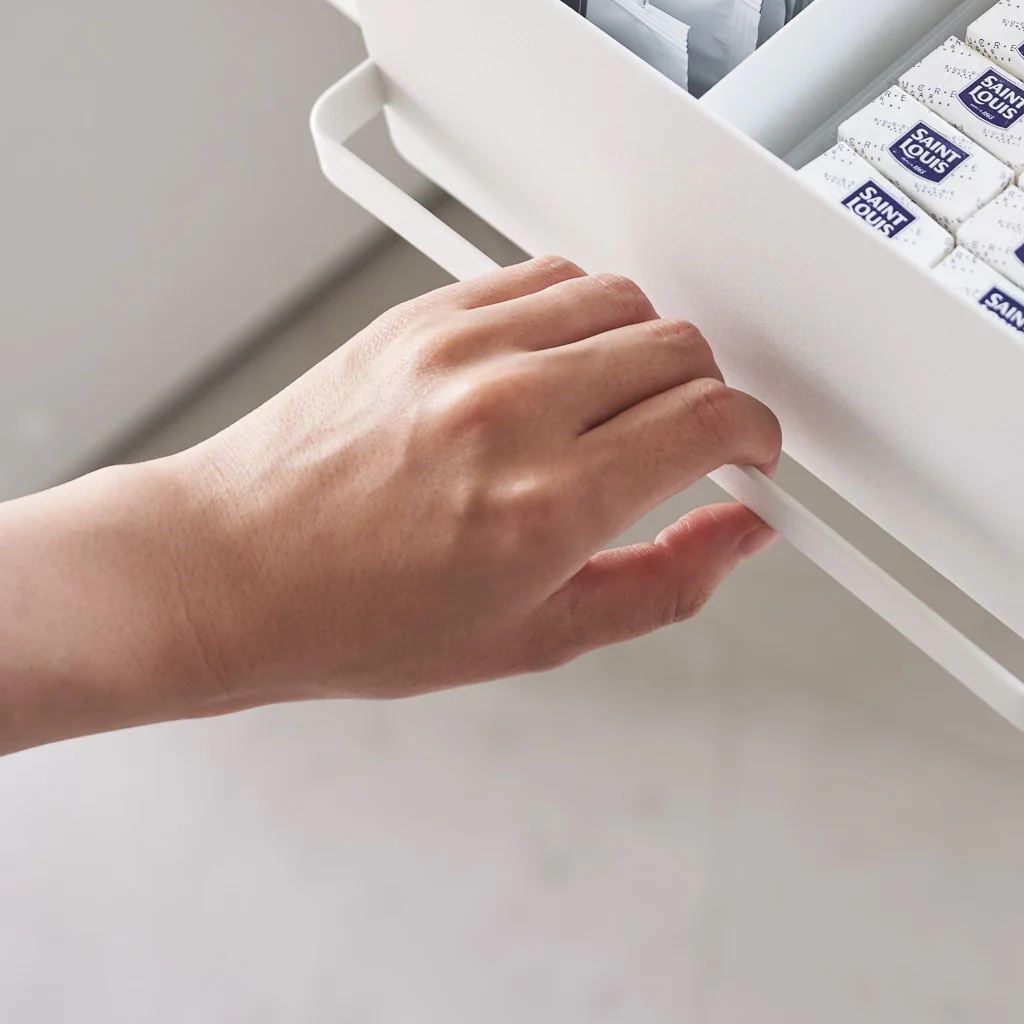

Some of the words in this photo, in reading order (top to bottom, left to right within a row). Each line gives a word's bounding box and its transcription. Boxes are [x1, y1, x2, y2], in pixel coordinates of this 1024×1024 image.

[968, 84, 1019, 121] LOUIS
[898, 137, 951, 175] LOUIS
[910, 127, 963, 164] SAINT
[845, 195, 896, 237] LOUIS
[858, 185, 909, 227] SAINT
